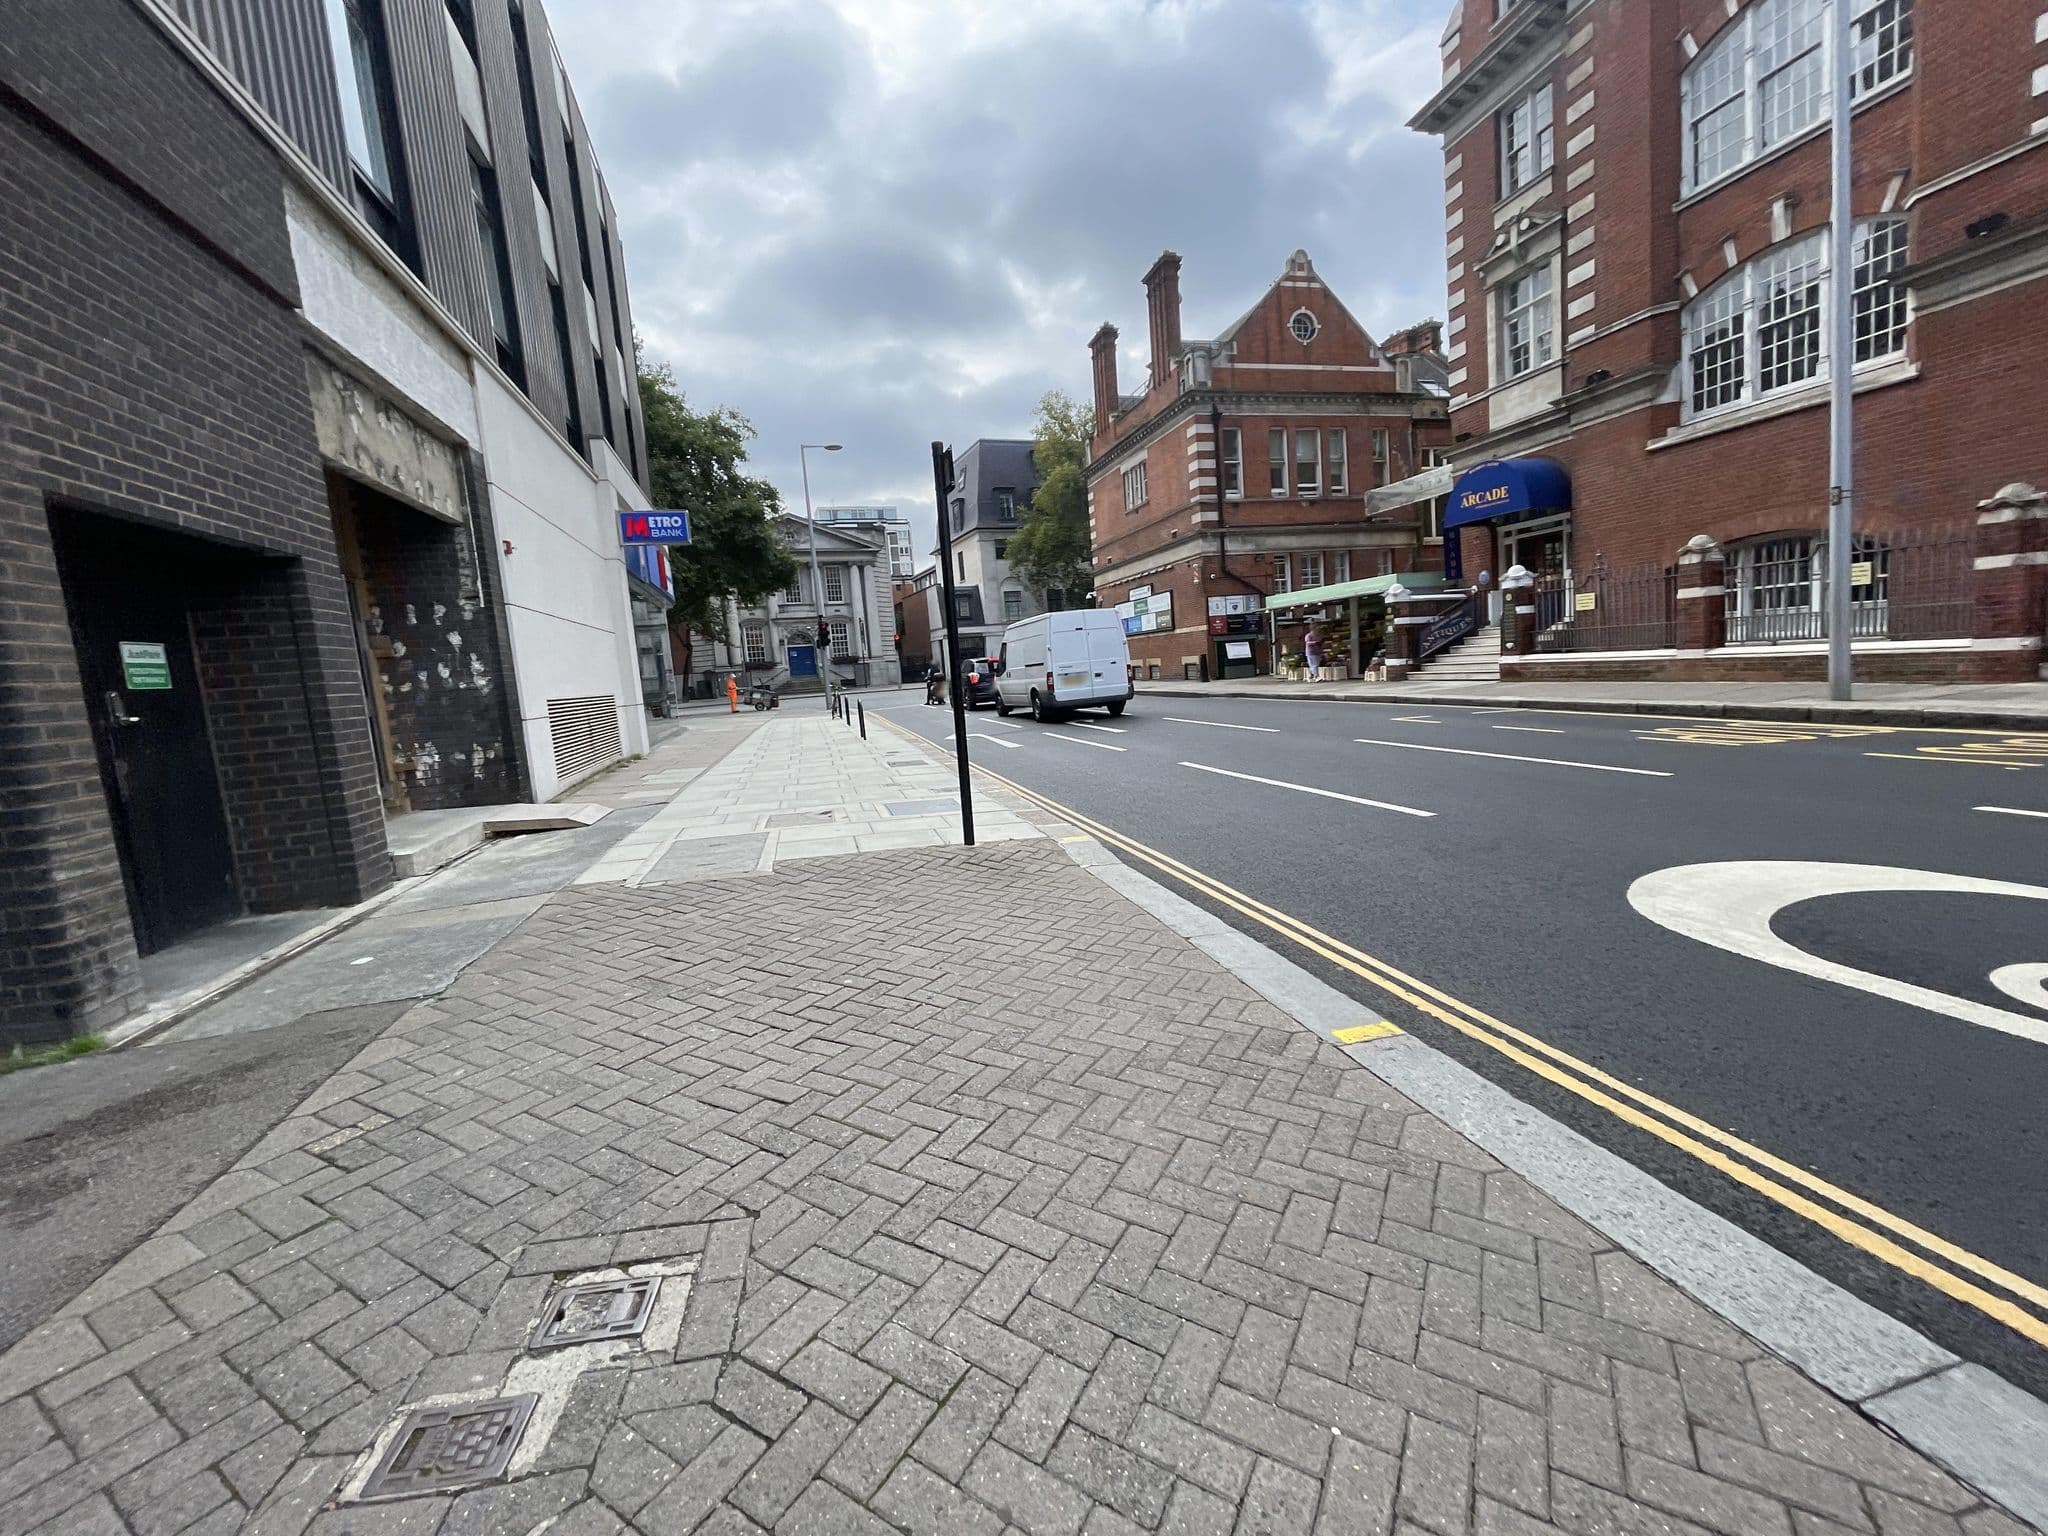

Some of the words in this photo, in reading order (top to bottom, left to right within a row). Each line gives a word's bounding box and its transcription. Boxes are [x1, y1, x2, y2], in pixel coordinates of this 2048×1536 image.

[1461, 486, 1509, 508] ARCADE
[626, 516, 682, 537] METRO
[651, 529, 683, 538] BANK
